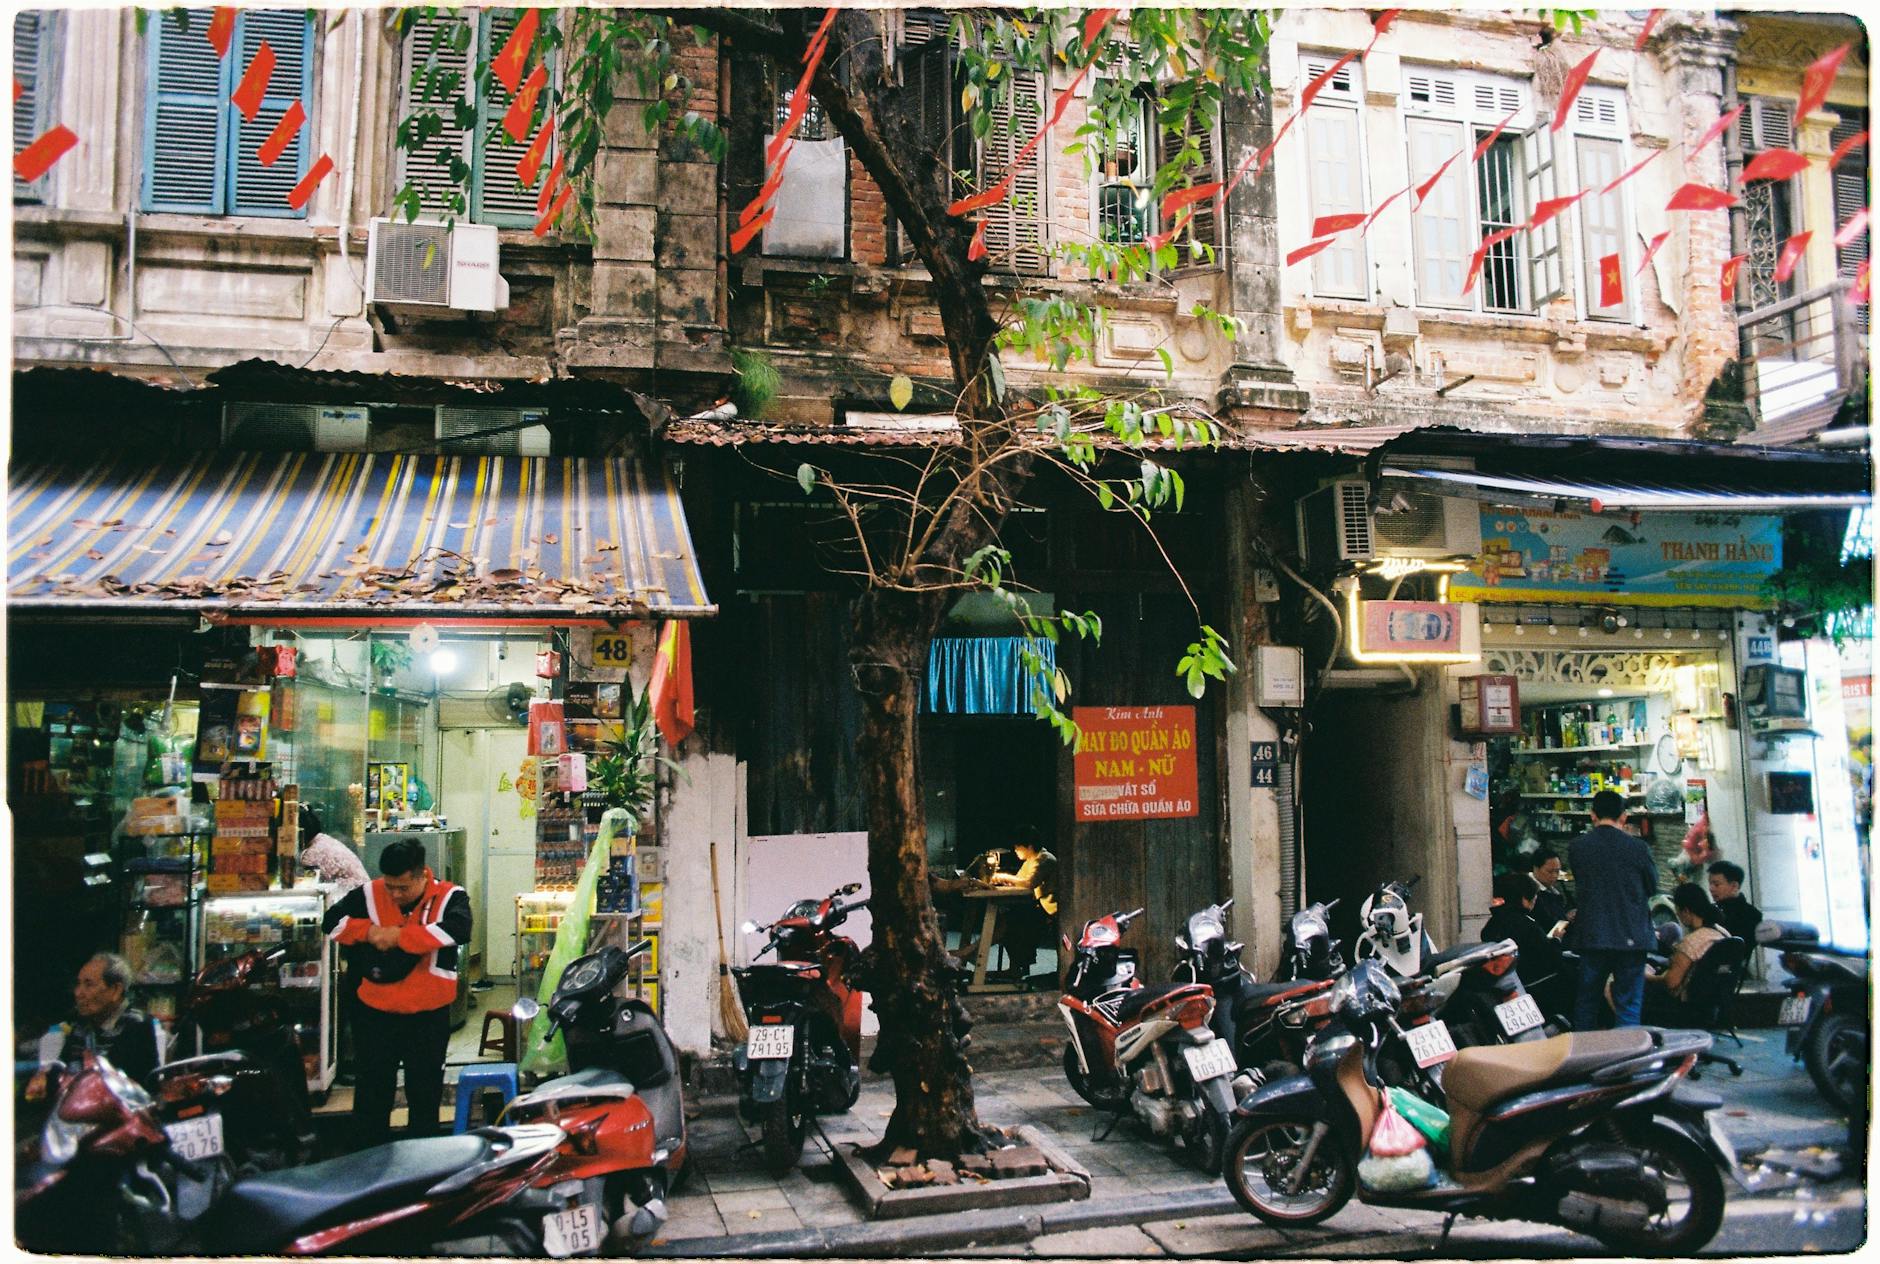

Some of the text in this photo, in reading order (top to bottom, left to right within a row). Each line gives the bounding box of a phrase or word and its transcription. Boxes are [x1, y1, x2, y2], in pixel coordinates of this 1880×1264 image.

[1661, 541, 1720, 561] THANH
[596, 639, 627, 661] 48
[1105, 706, 1164, 720] Kim Anh
[1080, 731, 1107, 752] MAY
[1131, 720, 1169, 756] QUẦN
[1172, 723, 1191, 750] ÁO
[1255, 745, 1273, 761] 46
[1095, 760, 1135, 778] NAM
[1256, 768, 1273, 784] 44
[755, 1028, 787, 1042] 29-C1
